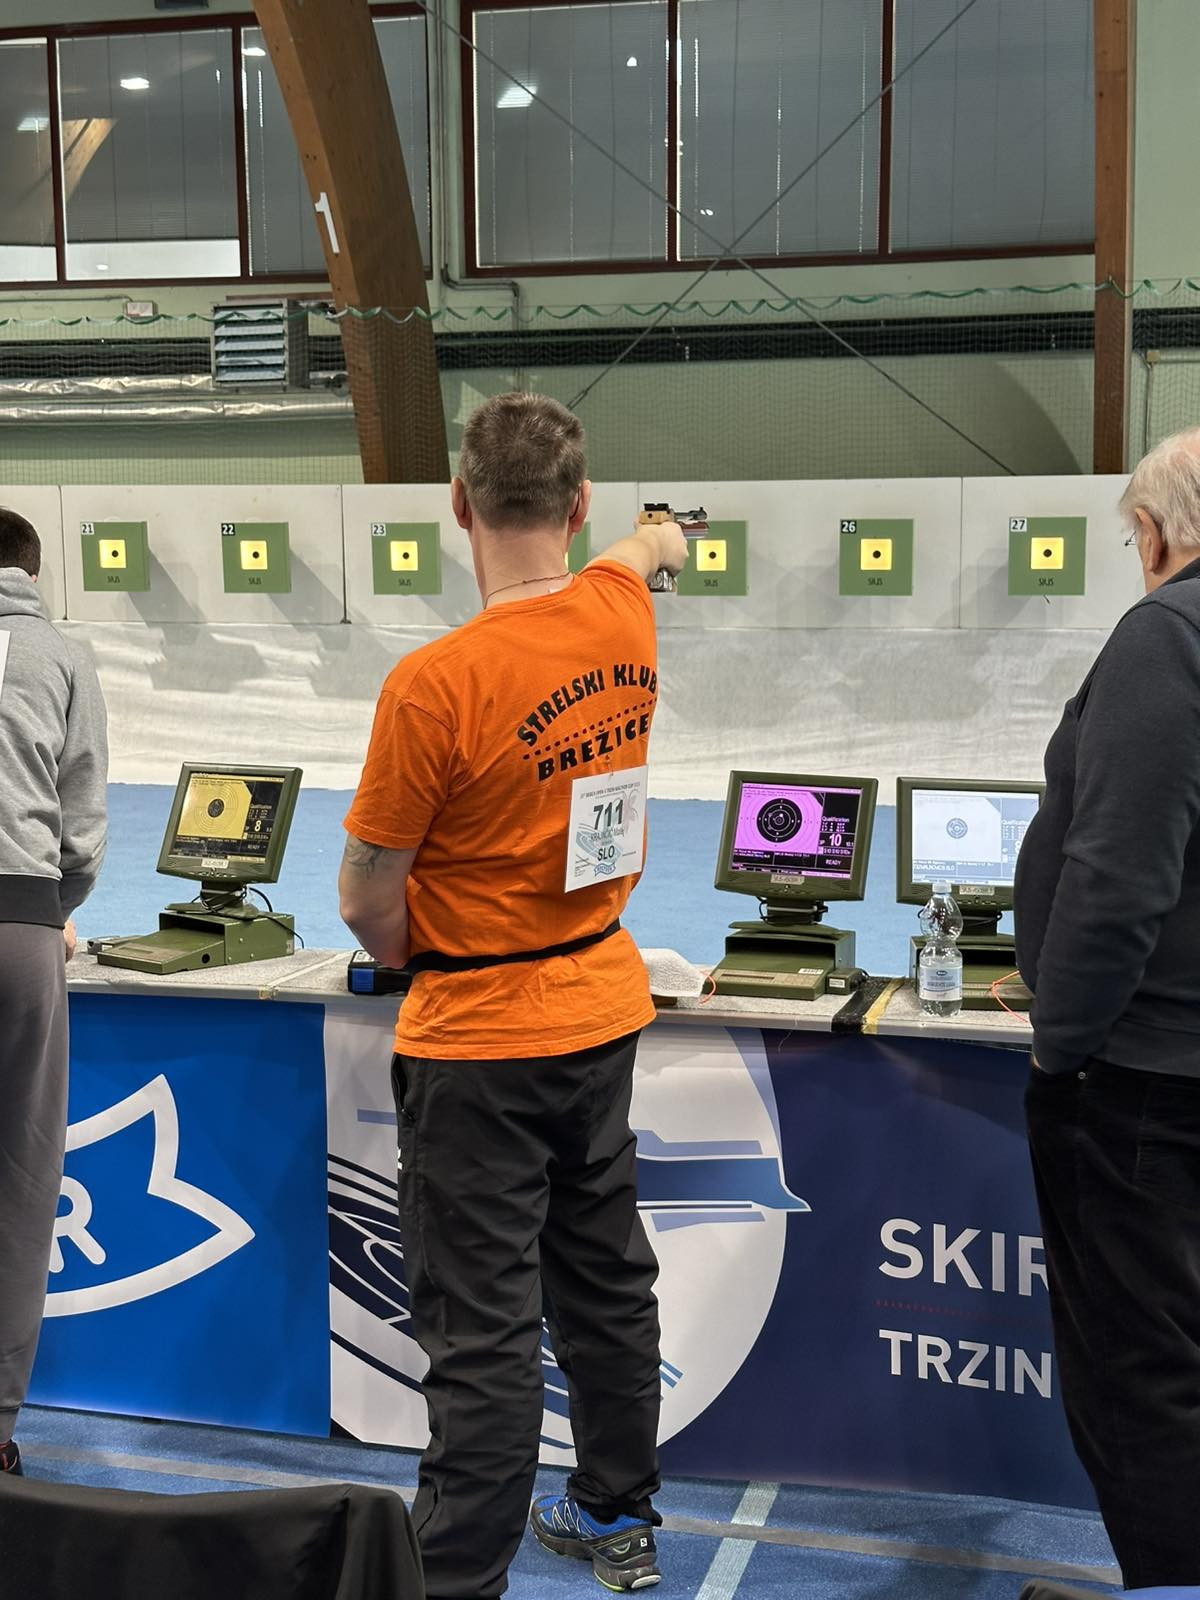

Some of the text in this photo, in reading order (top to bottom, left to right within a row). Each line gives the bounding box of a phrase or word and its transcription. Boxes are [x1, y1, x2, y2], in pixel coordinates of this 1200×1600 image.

[314, 192, 340, 253] 1
[82, 524, 93, 533] 21
[222, 525, 234, 534] 22
[373, 525, 385, 534] 23
[841, 522, 856, 532] 26
[1011, 520, 1025, 530] 27
[517, 664, 657, 747] STRELSKI KLUB
[537, 712, 649, 781] BREŽICE
[593, 800, 624, 830] 711
[254, 820, 261, 832] 8
[829, 833, 842, 847] 10
[597, 845, 615, 861] SLO
[49, 1175, 106, 1274] R
[878, 1218, 1050, 1297] SKIR
[879, 1329, 1052, 1399] TRZIN
